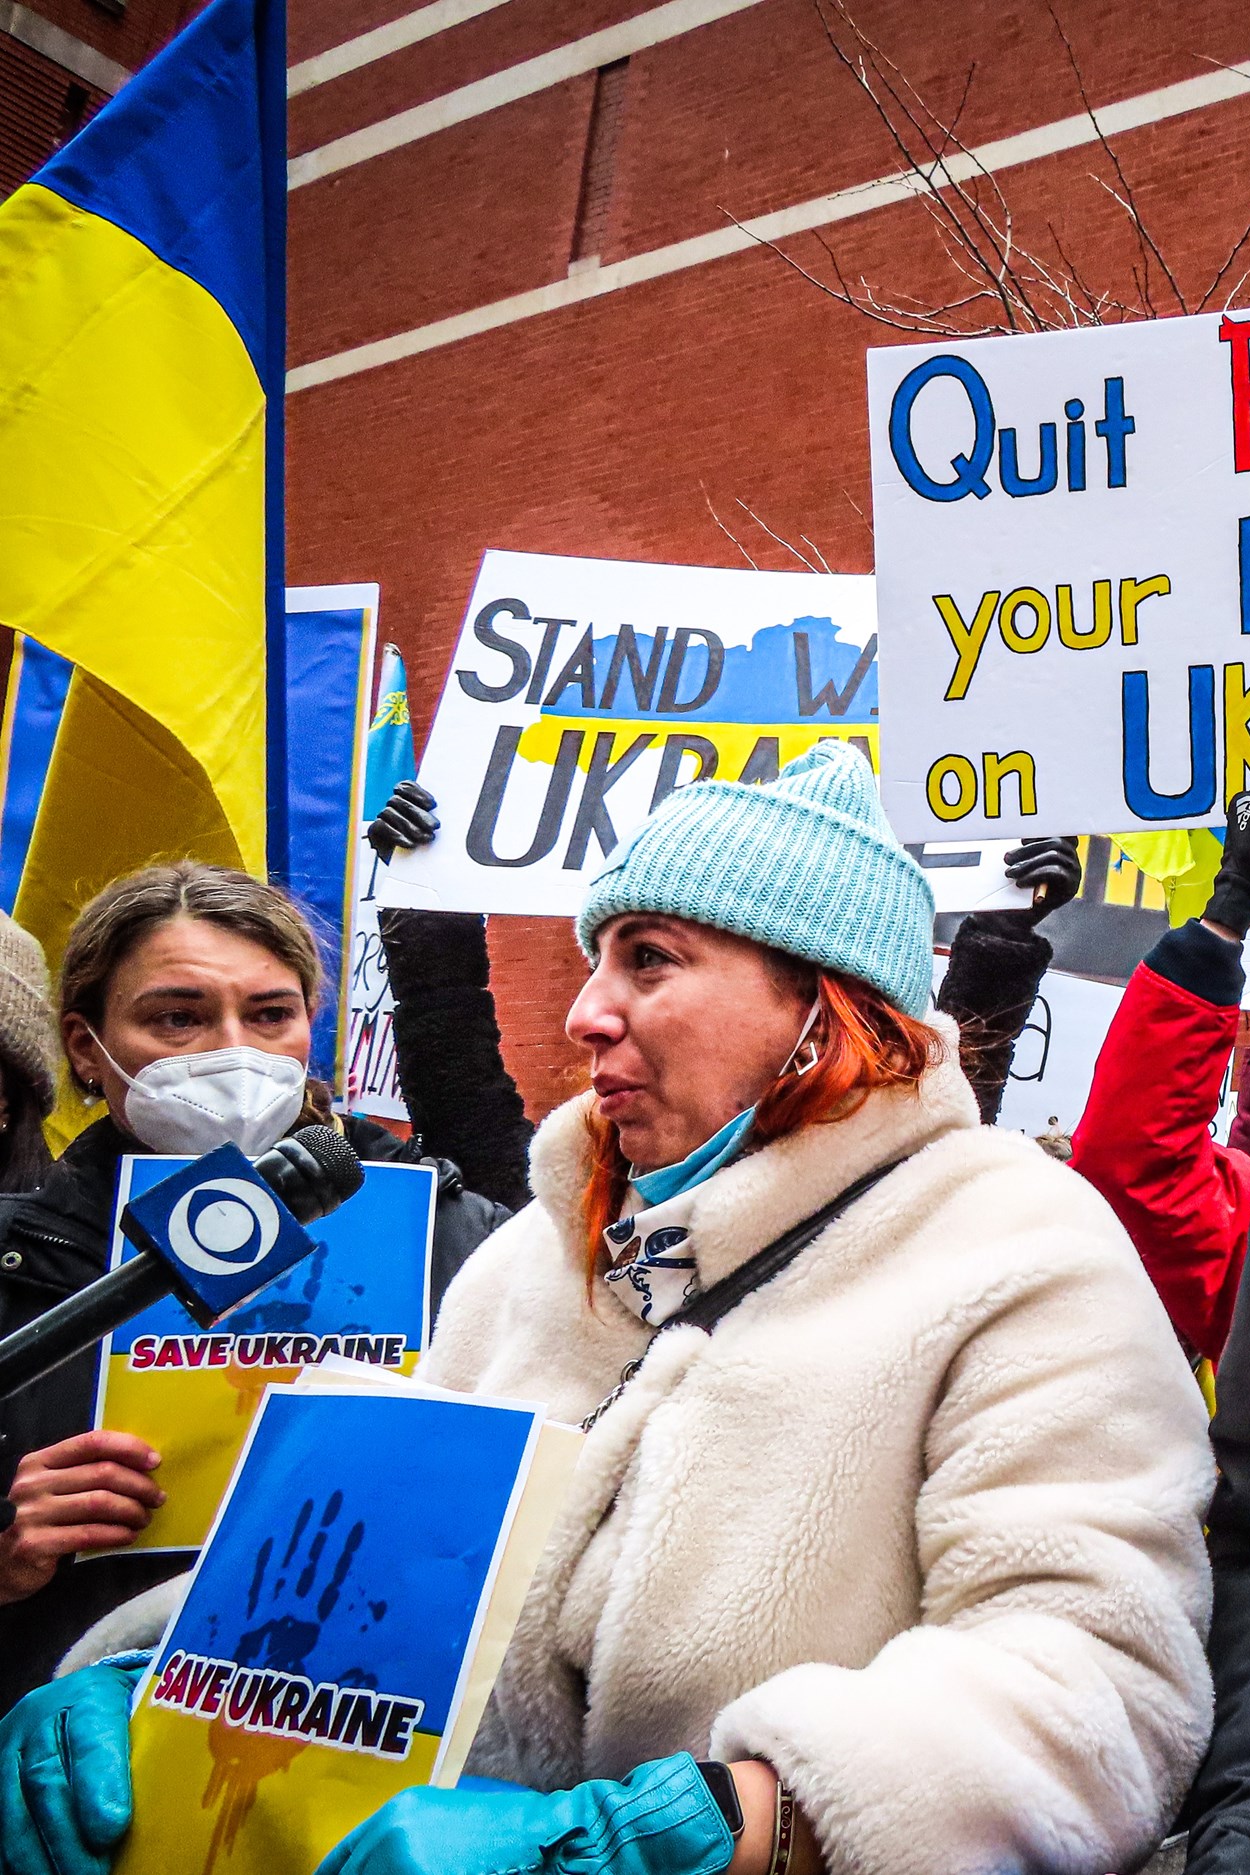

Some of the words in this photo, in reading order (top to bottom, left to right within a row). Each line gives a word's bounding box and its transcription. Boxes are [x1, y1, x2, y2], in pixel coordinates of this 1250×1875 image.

[887, 354, 1136, 503] Quit
[455, 597, 725, 714] STAND
[792, 631, 879, 717] W
[932, 572, 1172, 702] your
[926, 750, 1039, 823] on
[131, 1337, 231, 1369] SAVE
[237, 1335, 404, 1366] UKRAINE
[154, 1653, 233, 1714] SAVE
[227, 1672, 420, 1755] UKRAINE
